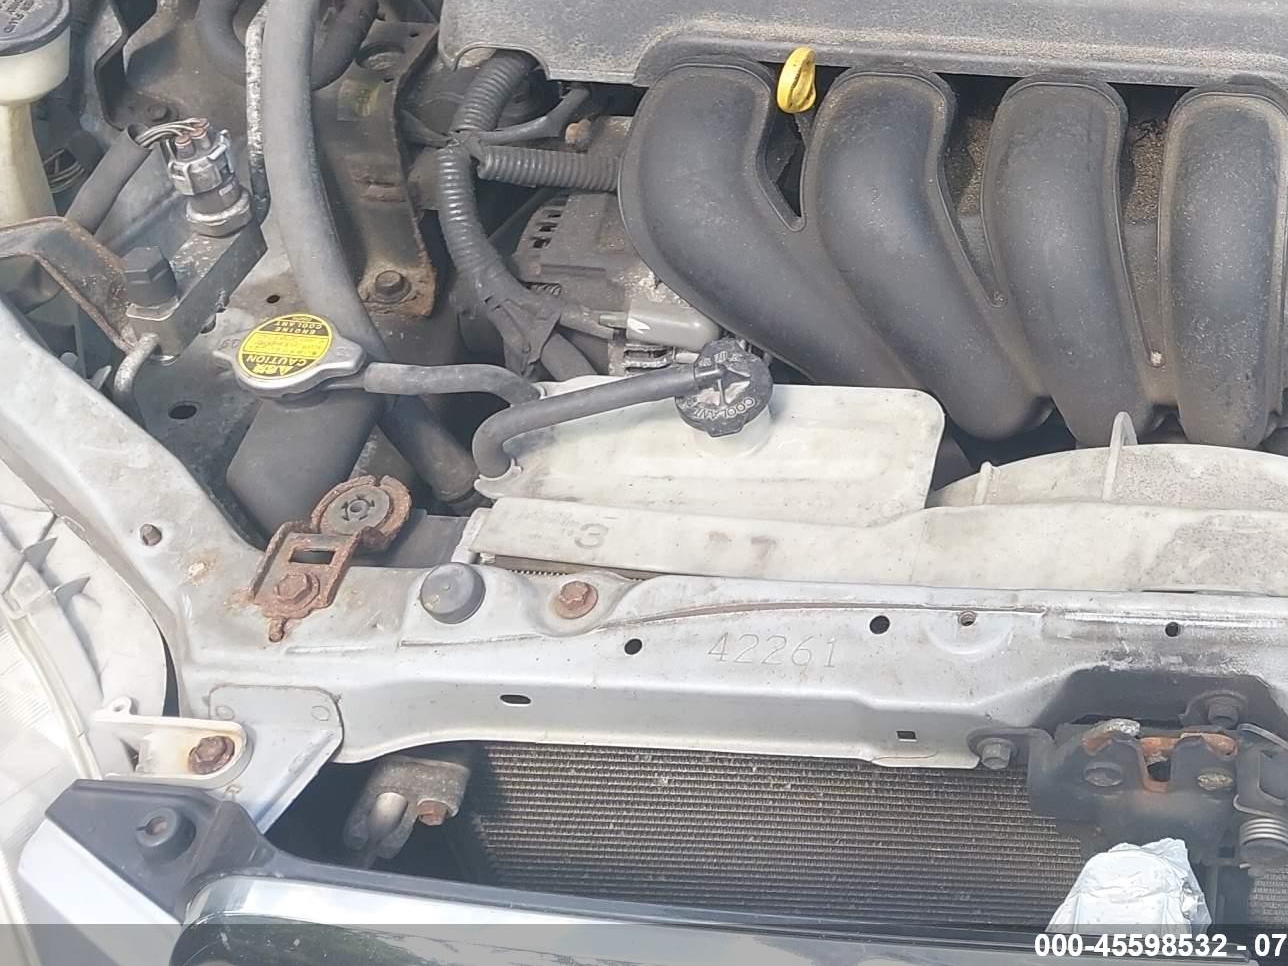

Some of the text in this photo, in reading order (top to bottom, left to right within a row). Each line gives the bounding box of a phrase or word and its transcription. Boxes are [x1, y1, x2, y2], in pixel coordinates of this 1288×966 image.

[273, 321, 323, 330] COOLANT
[246, 355, 307, 367] CAUTION
[694, 396, 756, 421] COOLANT
[707, 631, 838, 669] 42261
